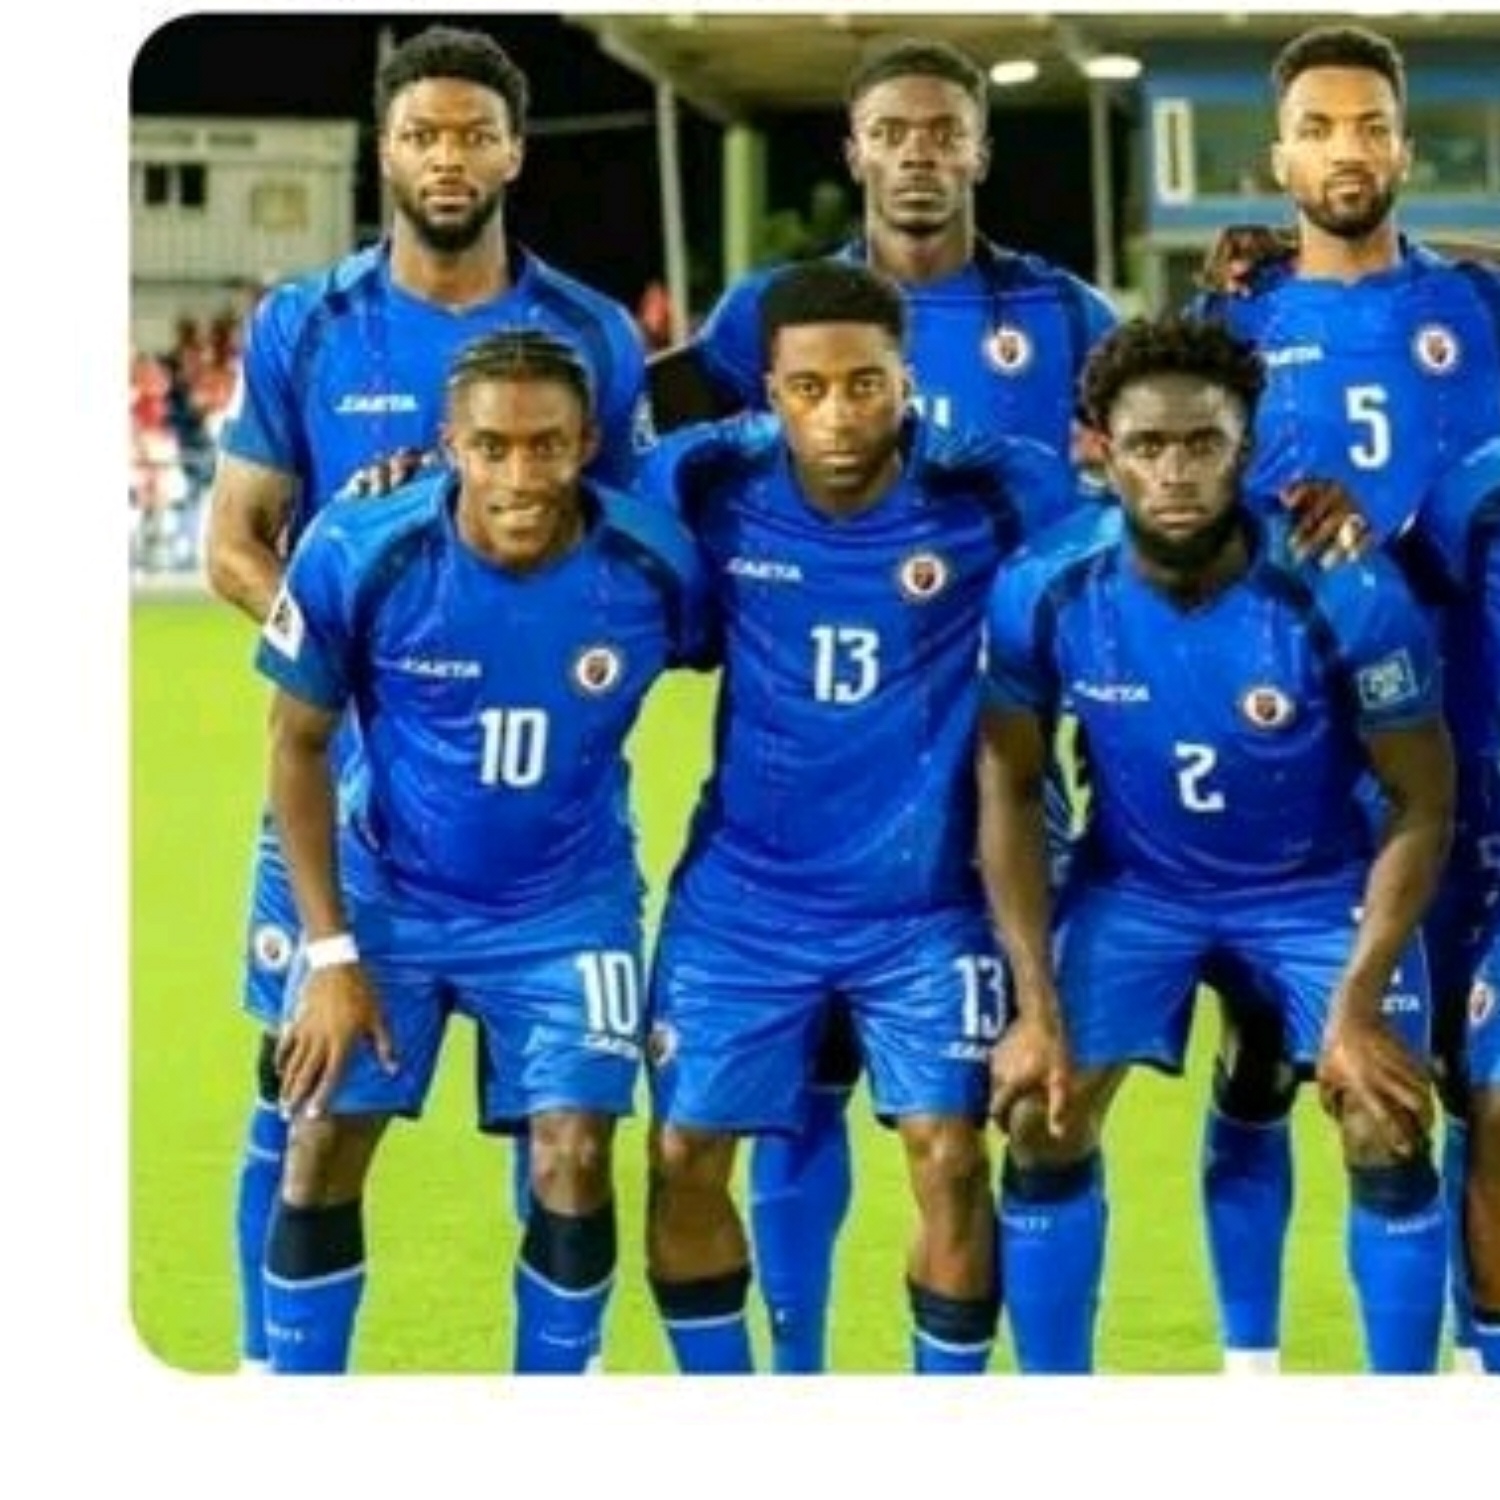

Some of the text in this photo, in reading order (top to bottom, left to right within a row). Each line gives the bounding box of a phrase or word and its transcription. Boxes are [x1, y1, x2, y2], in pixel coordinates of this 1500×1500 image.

[1345, 386, 1392, 470] 5
[810, 626, 880, 704] 13
[479, 708, 548, 788] 10
[1174, 741, 1226, 813] 2
[574, 950, 640, 1037] 10
[952, 954, 1008, 1040] 13
